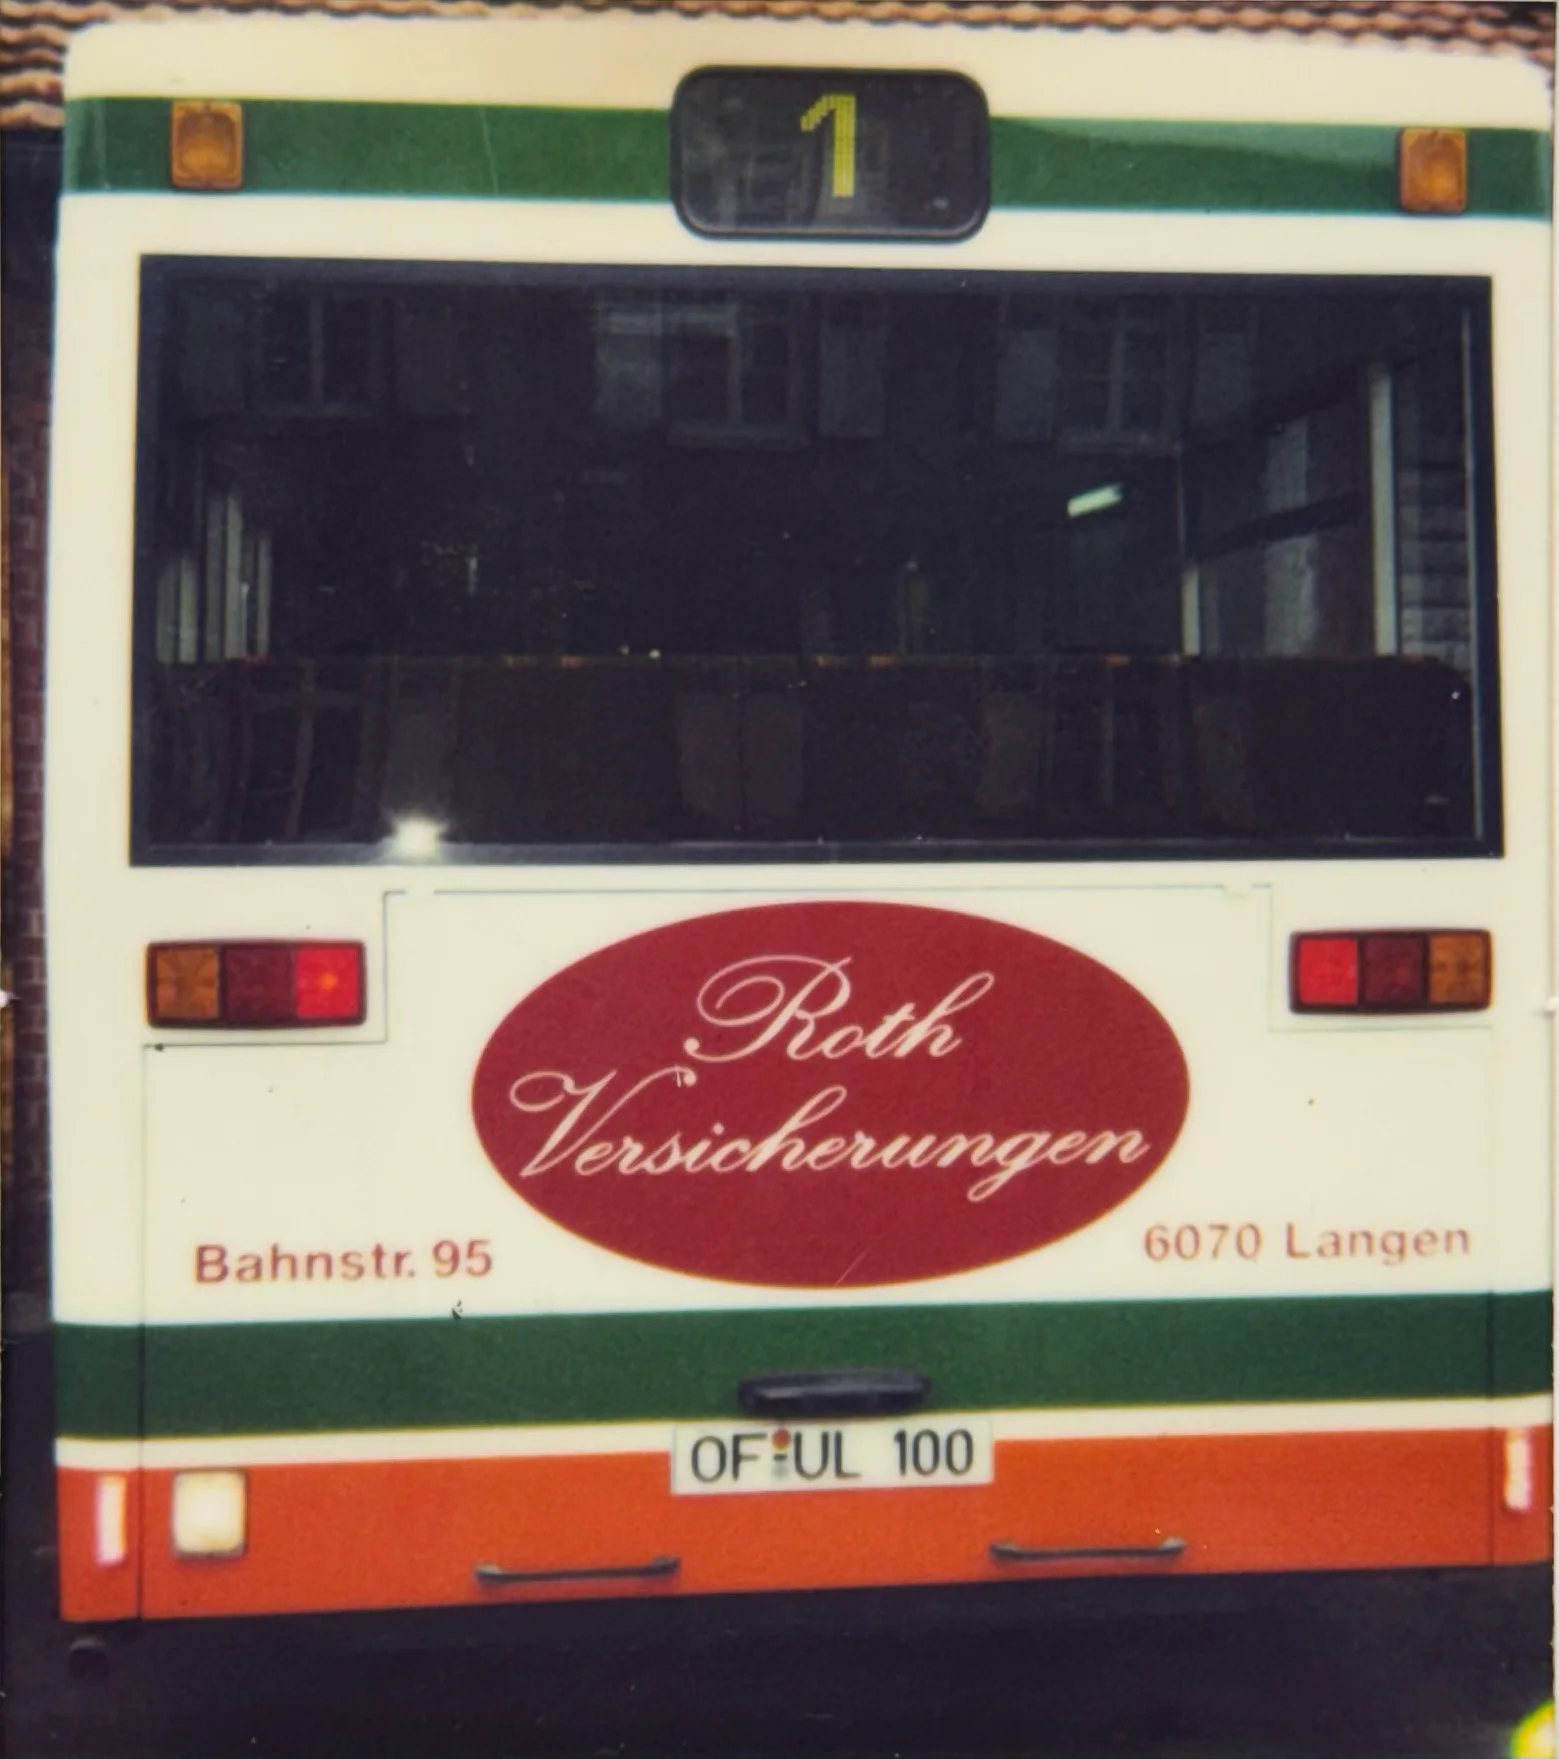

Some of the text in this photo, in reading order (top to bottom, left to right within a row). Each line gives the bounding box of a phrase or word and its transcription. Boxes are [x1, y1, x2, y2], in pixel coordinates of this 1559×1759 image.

[801, 94, 856, 197] 1
[684, 954, 996, 1063] Roth
[509, 1065, 1151, 1203] Versicherungen
[195, 1238, 494, 1284] Bahnstr. 95
[1143, 1221, 1472, 1266] 6070 Langen
[893, 1427, 975, 1477] 100
